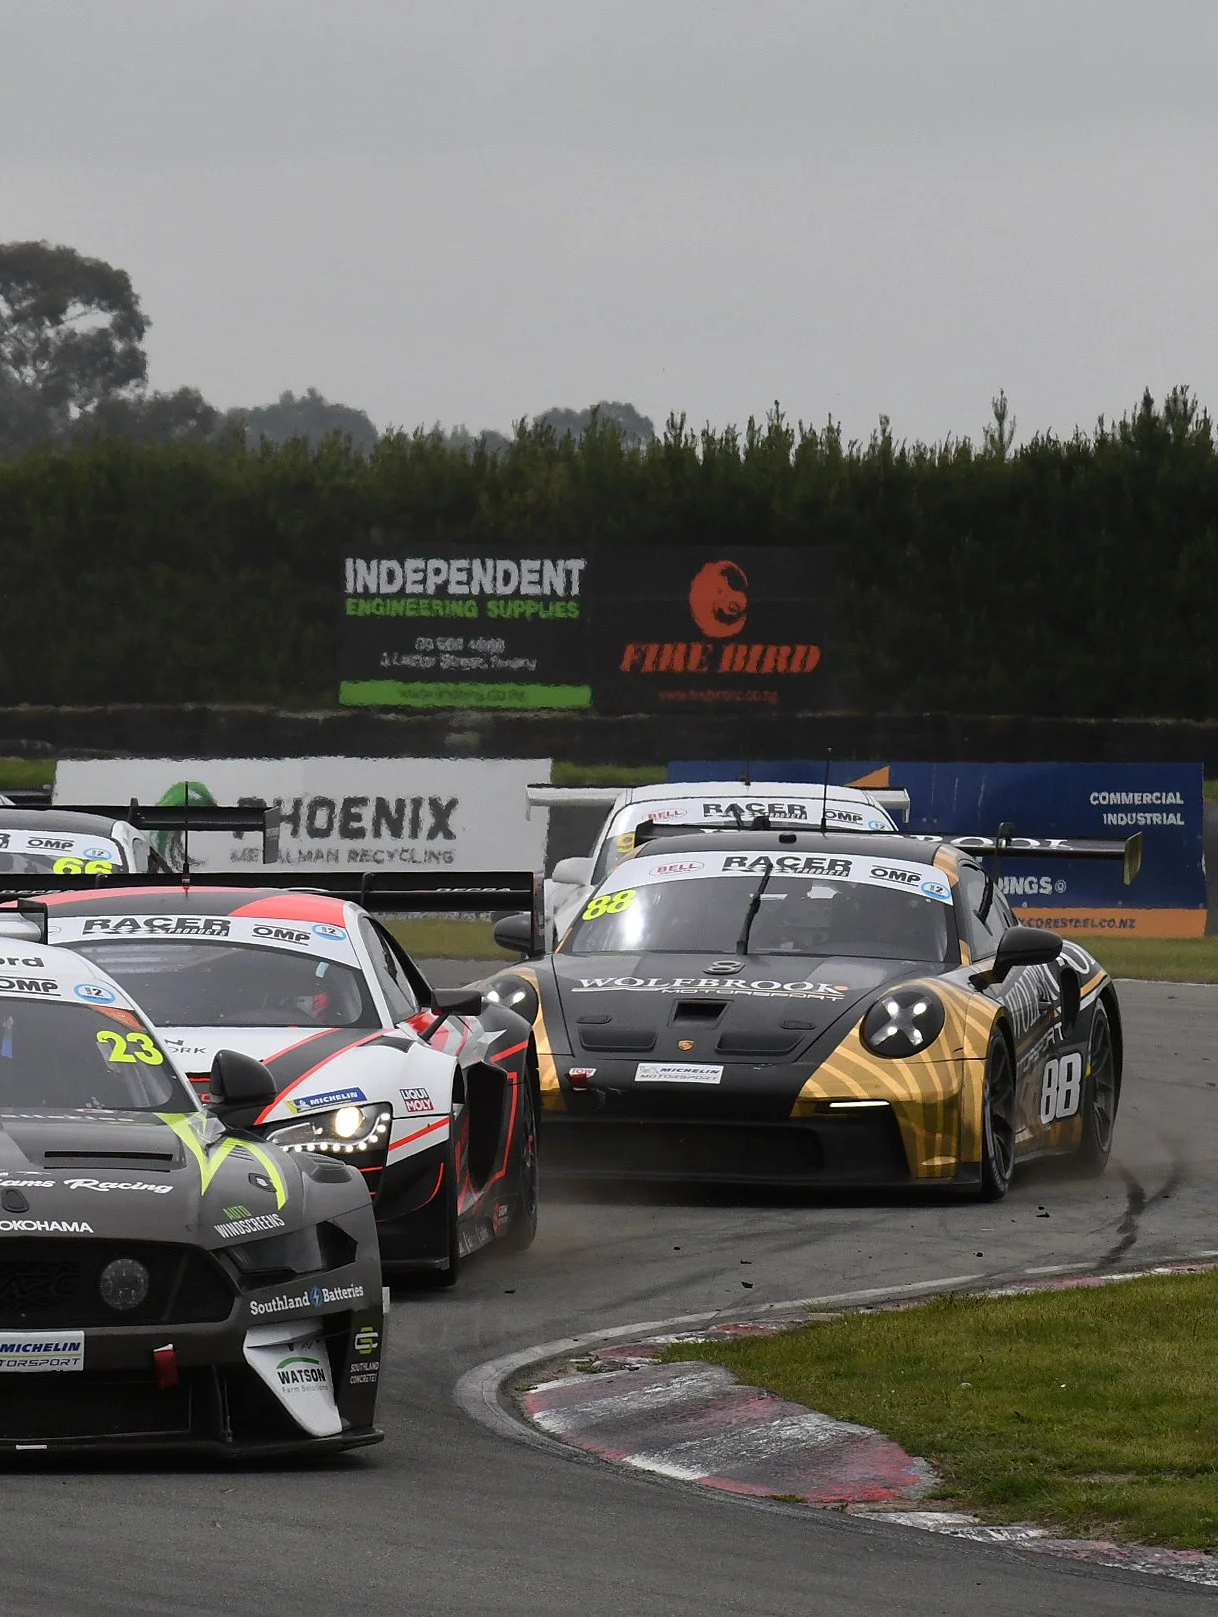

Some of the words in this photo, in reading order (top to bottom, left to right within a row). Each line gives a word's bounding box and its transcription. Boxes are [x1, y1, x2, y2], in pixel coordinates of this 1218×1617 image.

[344, 557, 586, 596] INDEPENDENT
[345, 598, 478, 618] ENGINEERING
[487, 600, 580, 619] SUPPLIES
[718, 643, 821, 674] BIRD
[1090, 791, 1184, 806] COMMERCIAL
[703, 803, 807, 815] RACER
[825, 810, 863, 823] OMP
[1103, 812, 1185, 826] INDUSTRIAL
[27, 839, 74, 850] OMP
[230, 848, 339, 864] MEALMAN
[348, 847, 455, 864] RECYCLING
[53, 857, 113, 874] 66
[657, 862, 698, 874] BELL
[722, 856, 853, 873] RACER
[870, 869, 921, 883] OMP
[582, 889, 637, 921] 88
[83, 917, 232, 932] RACER
[167, 927, 228, 936] PRODUCTS
[253, 926, 310, 942] OMP
[579, 976, 842, 994] WOLFBROOK
[661, 989, 845, 1001] MOTORSPORT
[97, 1030, 164, 1065] 23
[659, 1067, 720, 1075] MICHELIN
[400, 1088, 430, 1100] LIQUI
[1040, 1052, 1083, 1125] 88
[310, 1091, 358, 1106] MICHELIN
[405, 1099, 433, 1112] MOLY
[64, 1178, 175, 1194] Racing
[223, 1205, 252, 1220] AUTO
[213, 1212, 286, 1239] WINDSCREENS
[249, 1291, 310, 1316] Southland
[322, 1283, 364, 1303] Batteries
[0, 1341, 81, 1353] MICHELIN
[350, 1361, 380, 1373] SOUTHLAND
[277, 1368, 326, 1385] WATSON
